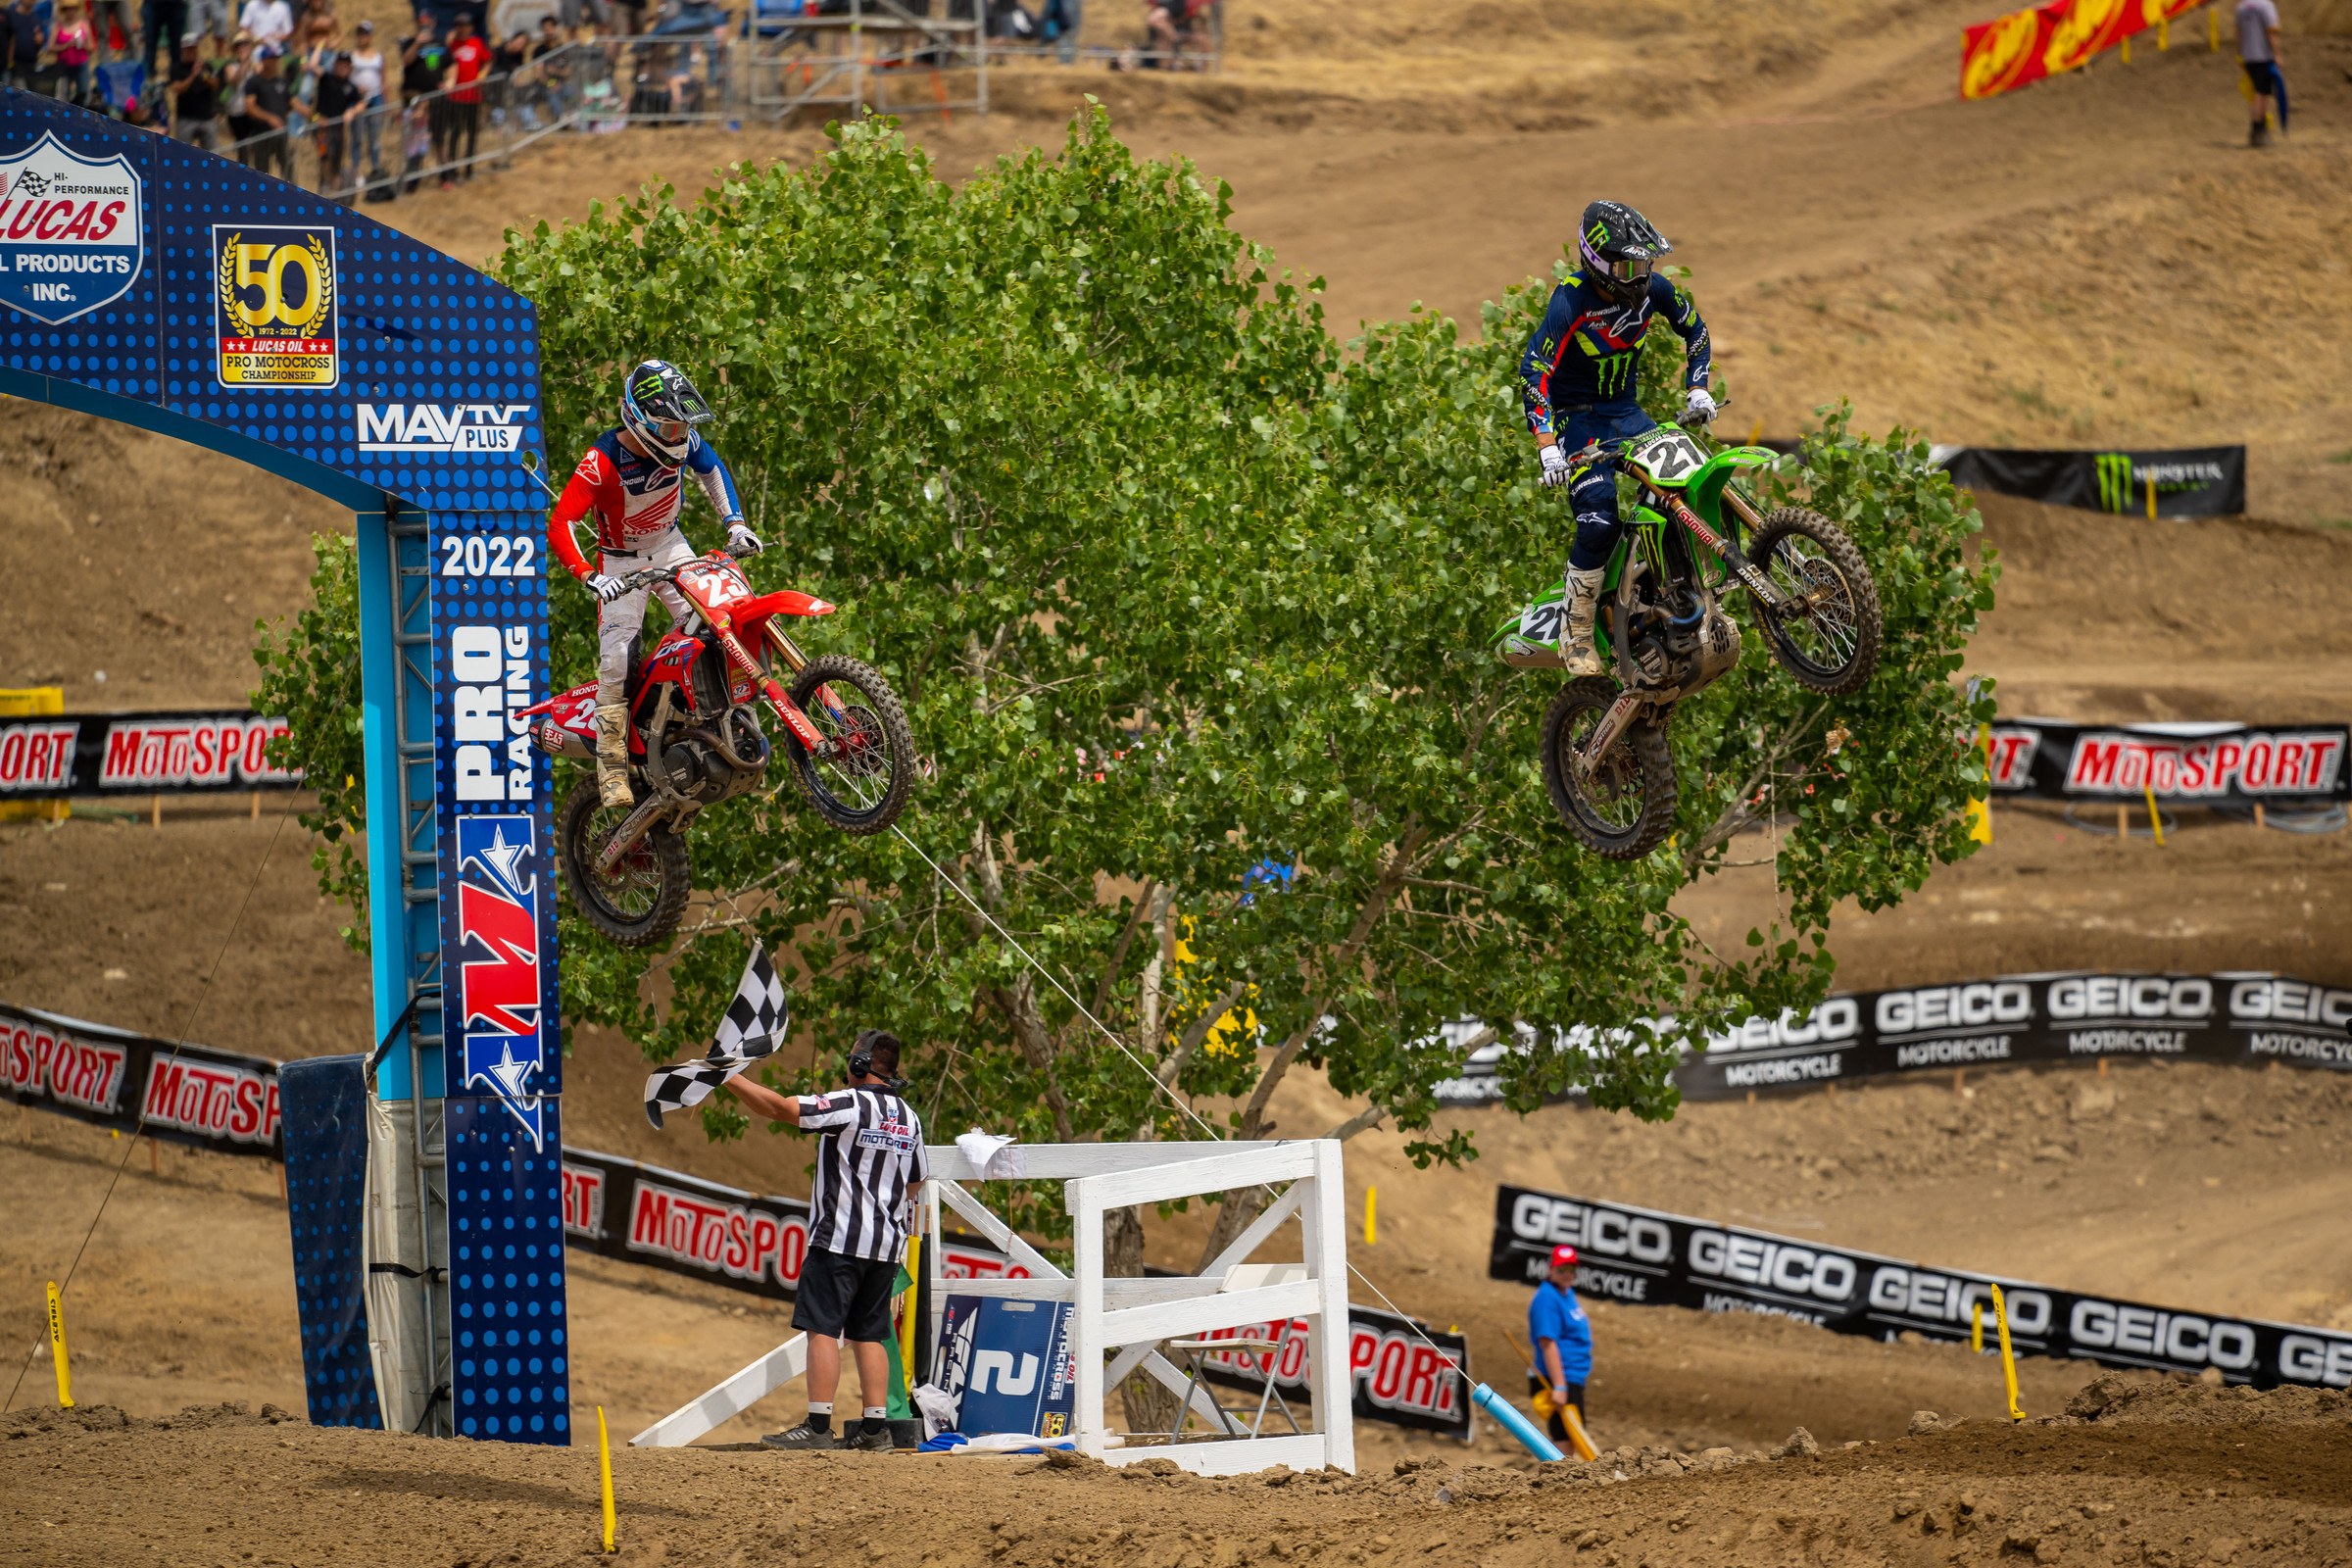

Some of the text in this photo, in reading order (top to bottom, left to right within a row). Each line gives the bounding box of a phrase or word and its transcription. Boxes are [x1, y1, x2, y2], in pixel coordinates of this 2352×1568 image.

[54, 185, 129, 195] PERFORMANCE
[0, 199, 126, 241] LUCAS
[16, 254, 130, 273] PRODUCTS
[235, 243, 323, 326] 50
[1586, 304, 1621, 318] Kawasaki
[252, 340, 305, 353] LUCAS OIL
[280, 327, 297, 336] 2022
[226, 356, 330, 368] PRO MOTOCROSS
[241, 370, 317, 380] CHAMPIONSHIP
[466, 428, 511, 449] PLUS
[1646, 438, 1704, 478] 21
[618, 475, 646, 487] SHOWA
[1571, 473, 1604, 497] Kawasaki
[1678, 512, 1714, 546] SHOWA
[442, 536, 535, 576] 2022
[698, 567, 750, 608] 23
[1737, 566, 1777, 605] DUNLOP
[722, 637, 756, 675] SHOWA
[452, 625, 533, 802] PRO RACING
[773, 699, 811, 740] DUNLOP
[106, 724, 303, 778] MOTOSPO
[2075, 740, 2337, 790] MOTOSPORT
[1875, 982, 2032, 1033] GEICO
[2047, 977, 2213, 1018] GEICO
[1898, 1035, 2012, 1066] MOTORCYCLE
[2069, 1030, 2185, 1054] MOTORCYCLE
[1725, 1053, 1841, 1088] MOTORCYCLE
[147, 1062, 281, 1139] MOTOSP
[634, 1188, 805, 1281] MOTOSPO
[1511, 1193, 1671, 1263] GEICO
[1688, 1229, 1857, 1301] GEICO
[1868, 1266, 2052, 1336] GEICO
[2069, 1299, 2256, 1369] GEICO
[943, 1332, 958, 1391] RACIN
[970, 1349, 1040, 1396] 2
